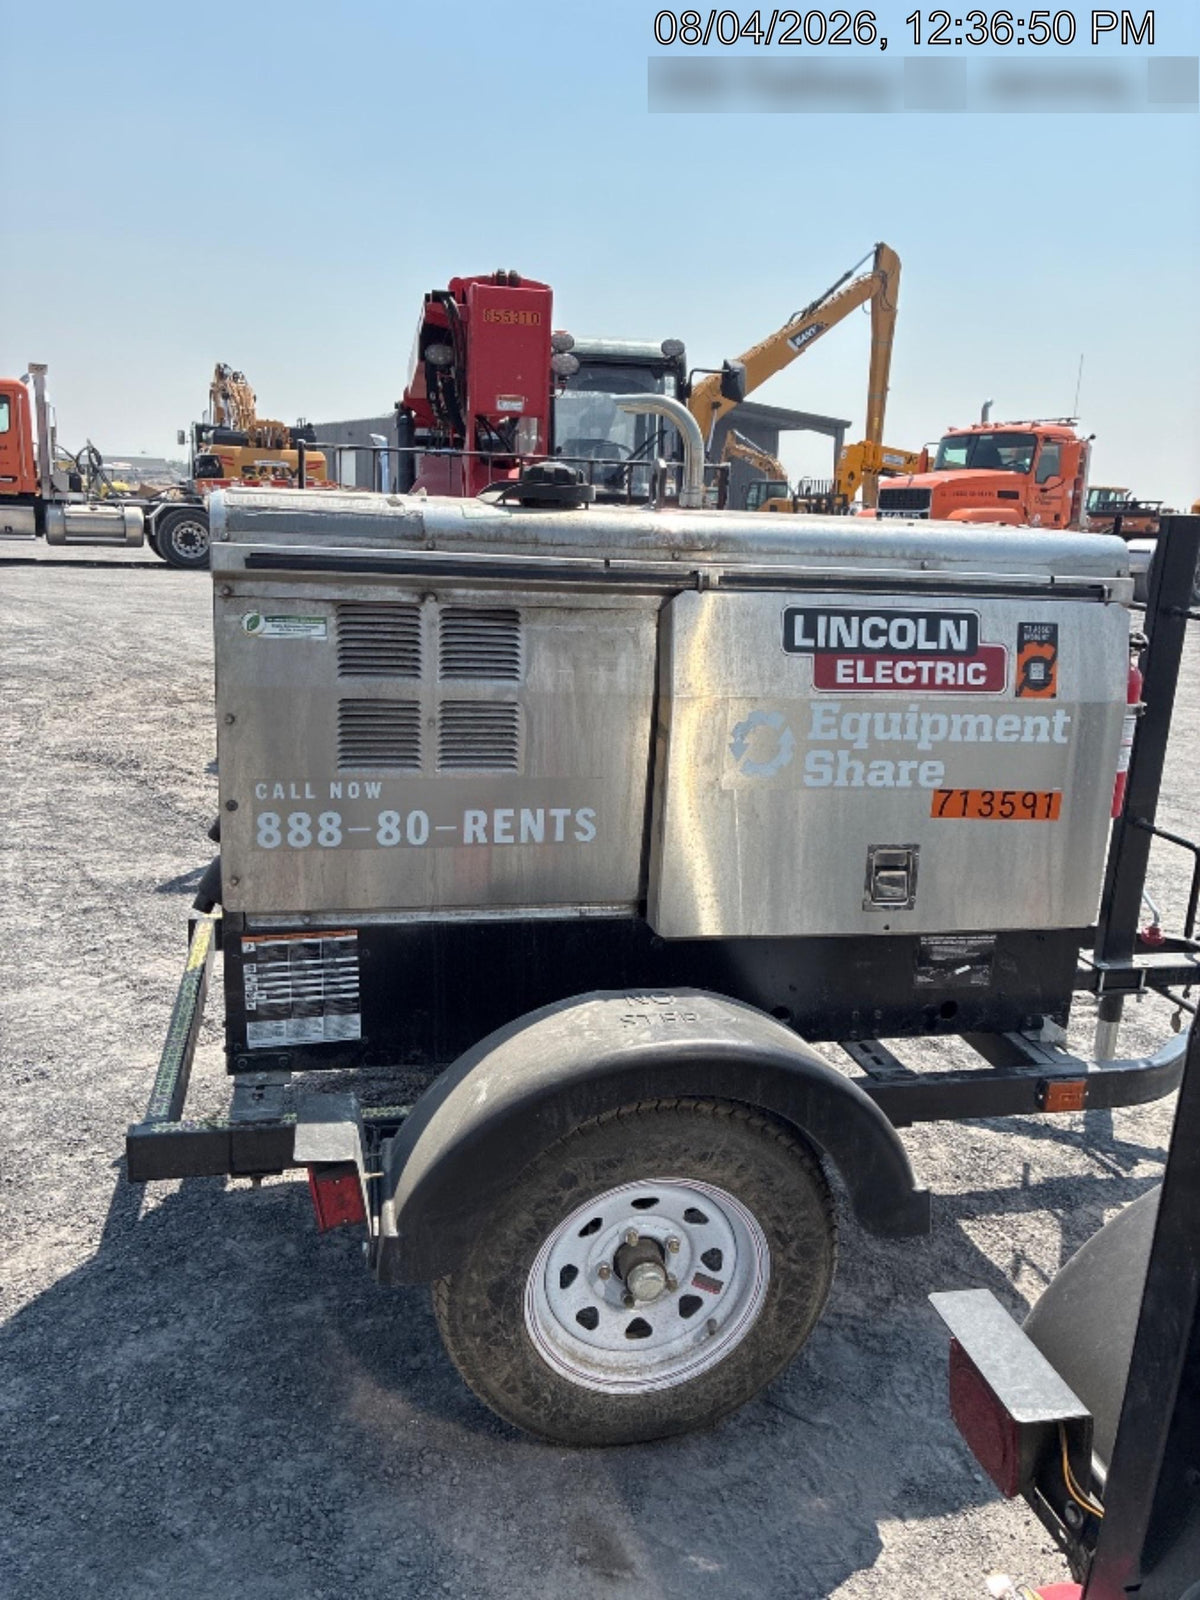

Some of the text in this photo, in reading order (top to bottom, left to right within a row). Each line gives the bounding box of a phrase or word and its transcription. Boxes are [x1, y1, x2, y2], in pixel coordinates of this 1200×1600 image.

[793, 614, 968, 651] LINCOLN
[835, 659, 987, 686] ELECTRIC
[808, 702, 1071, 750] Equipment
[803, 749, 945, 789] Share
[255, 782, 383, 800] CALL NOW
[937, 789, 1055, 819] 713591
[256, 808, 597, 849] 888-80-RENTS
